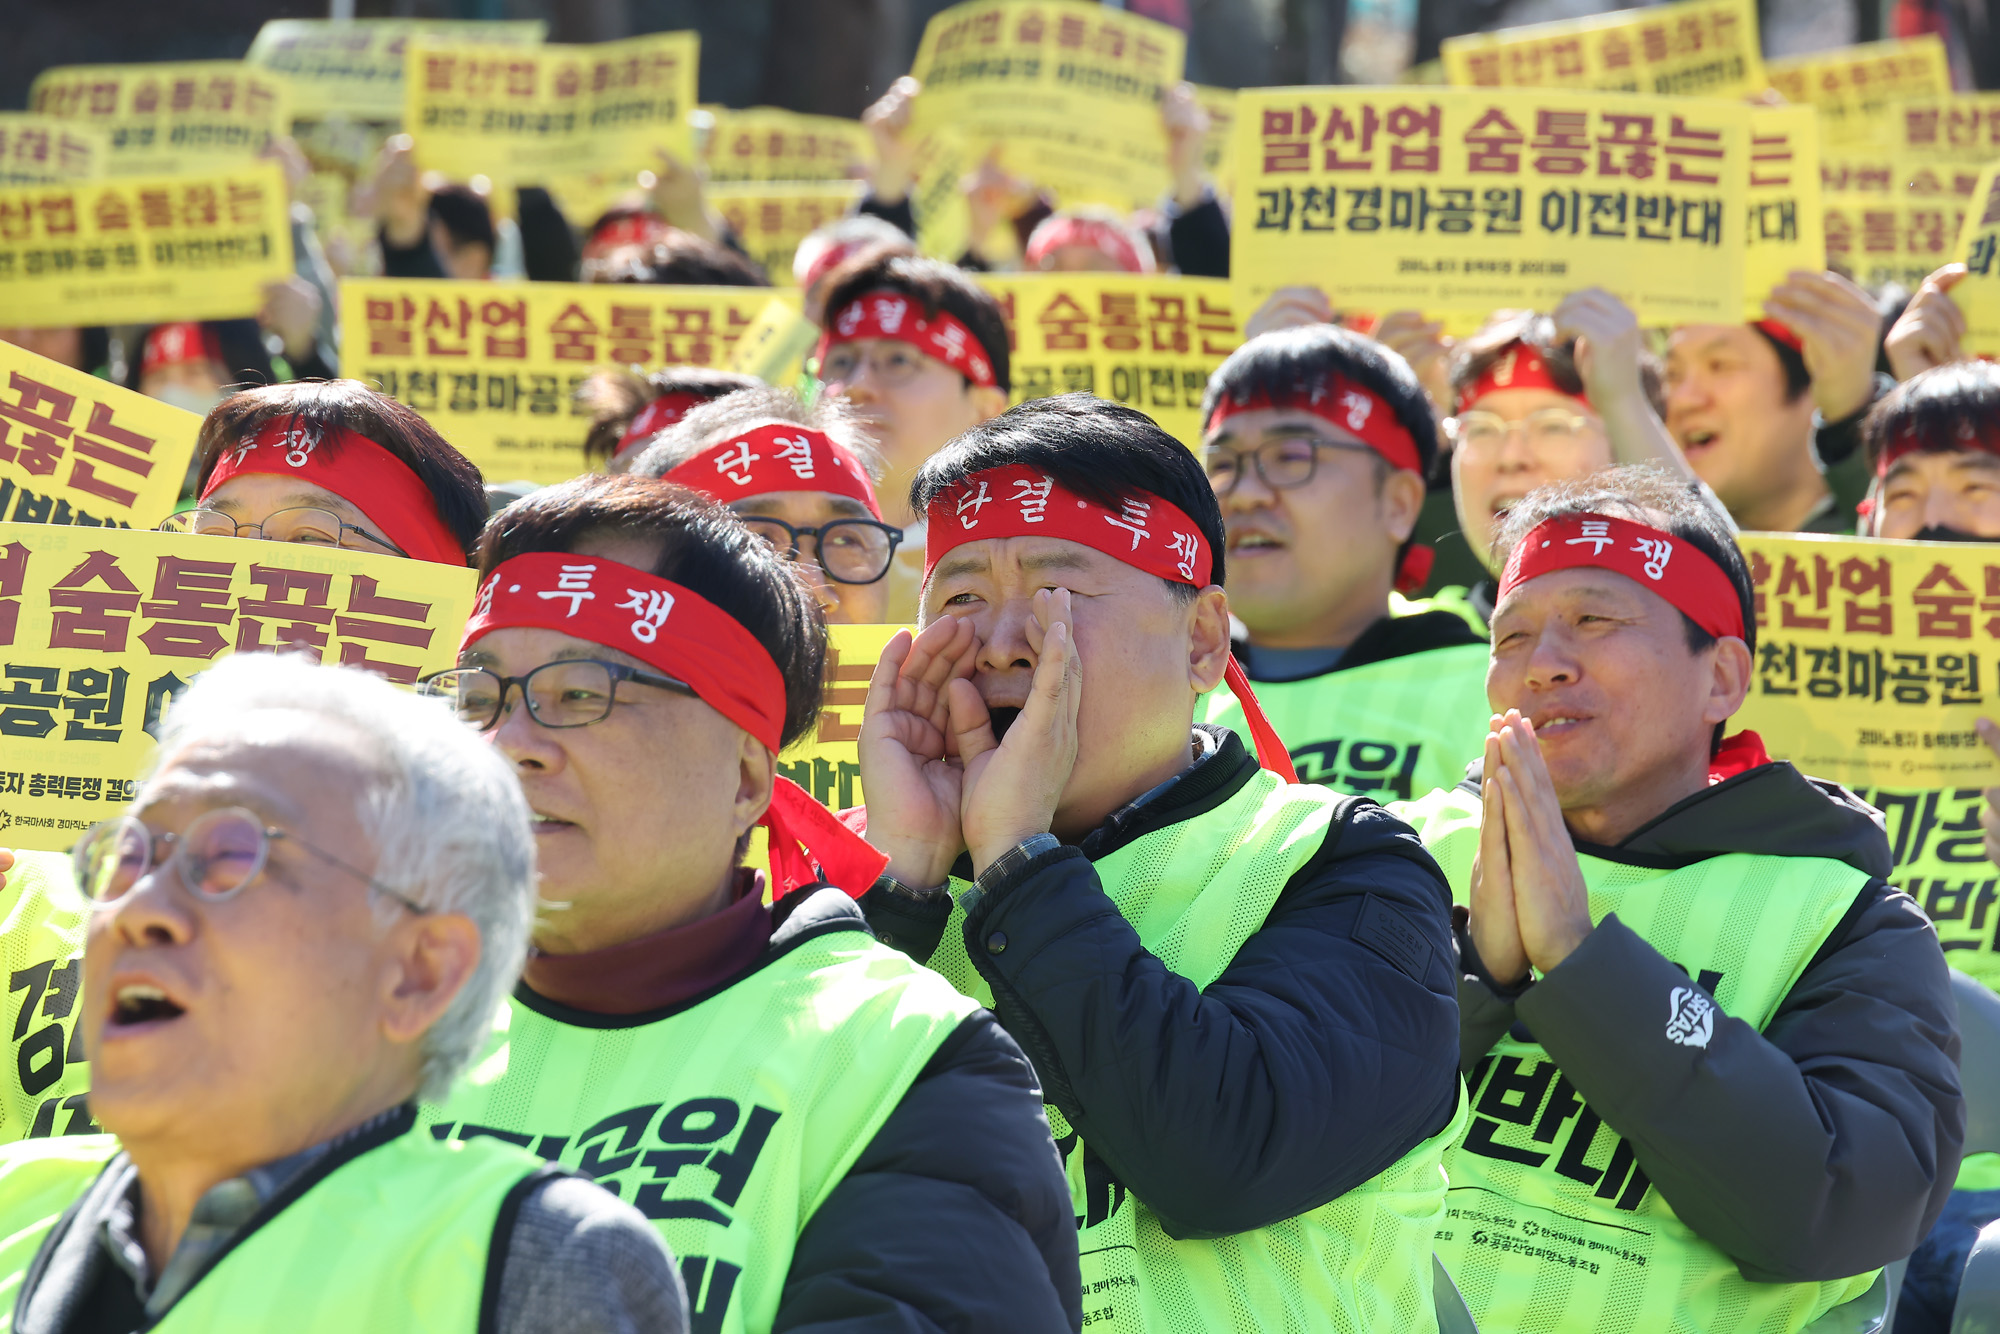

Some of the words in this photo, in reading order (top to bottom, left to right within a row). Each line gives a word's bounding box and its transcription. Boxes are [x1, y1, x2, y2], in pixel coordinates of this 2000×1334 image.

[1262, 104, 1443, 175] 말산업
[1463, 107, 1725, 184] 숨통끊는
[1254, 184, 1524, 236] 과천경마공원
[1539, 185, 1723, 246] 이전반대
[364, 296, 528, 358] 말산업
[1038, 289, 1237, 355] 숨통끊는
[714, 435, 816, 485] 단결
[956, 474, 1055, 530] 단결
[1104, 497, 1200, 581] 투쟁
[1564, 520, 1673, 581] 투쟁
[48, 548, 437, 685] 숨통끊는
[537, 564, 676, 644] 투쟁
[1748, 640, 1984, 707] 천경마공원
[29, 773, 102, 801] 총력투쟁
[14, 815, 55, 828] 한국마사회
